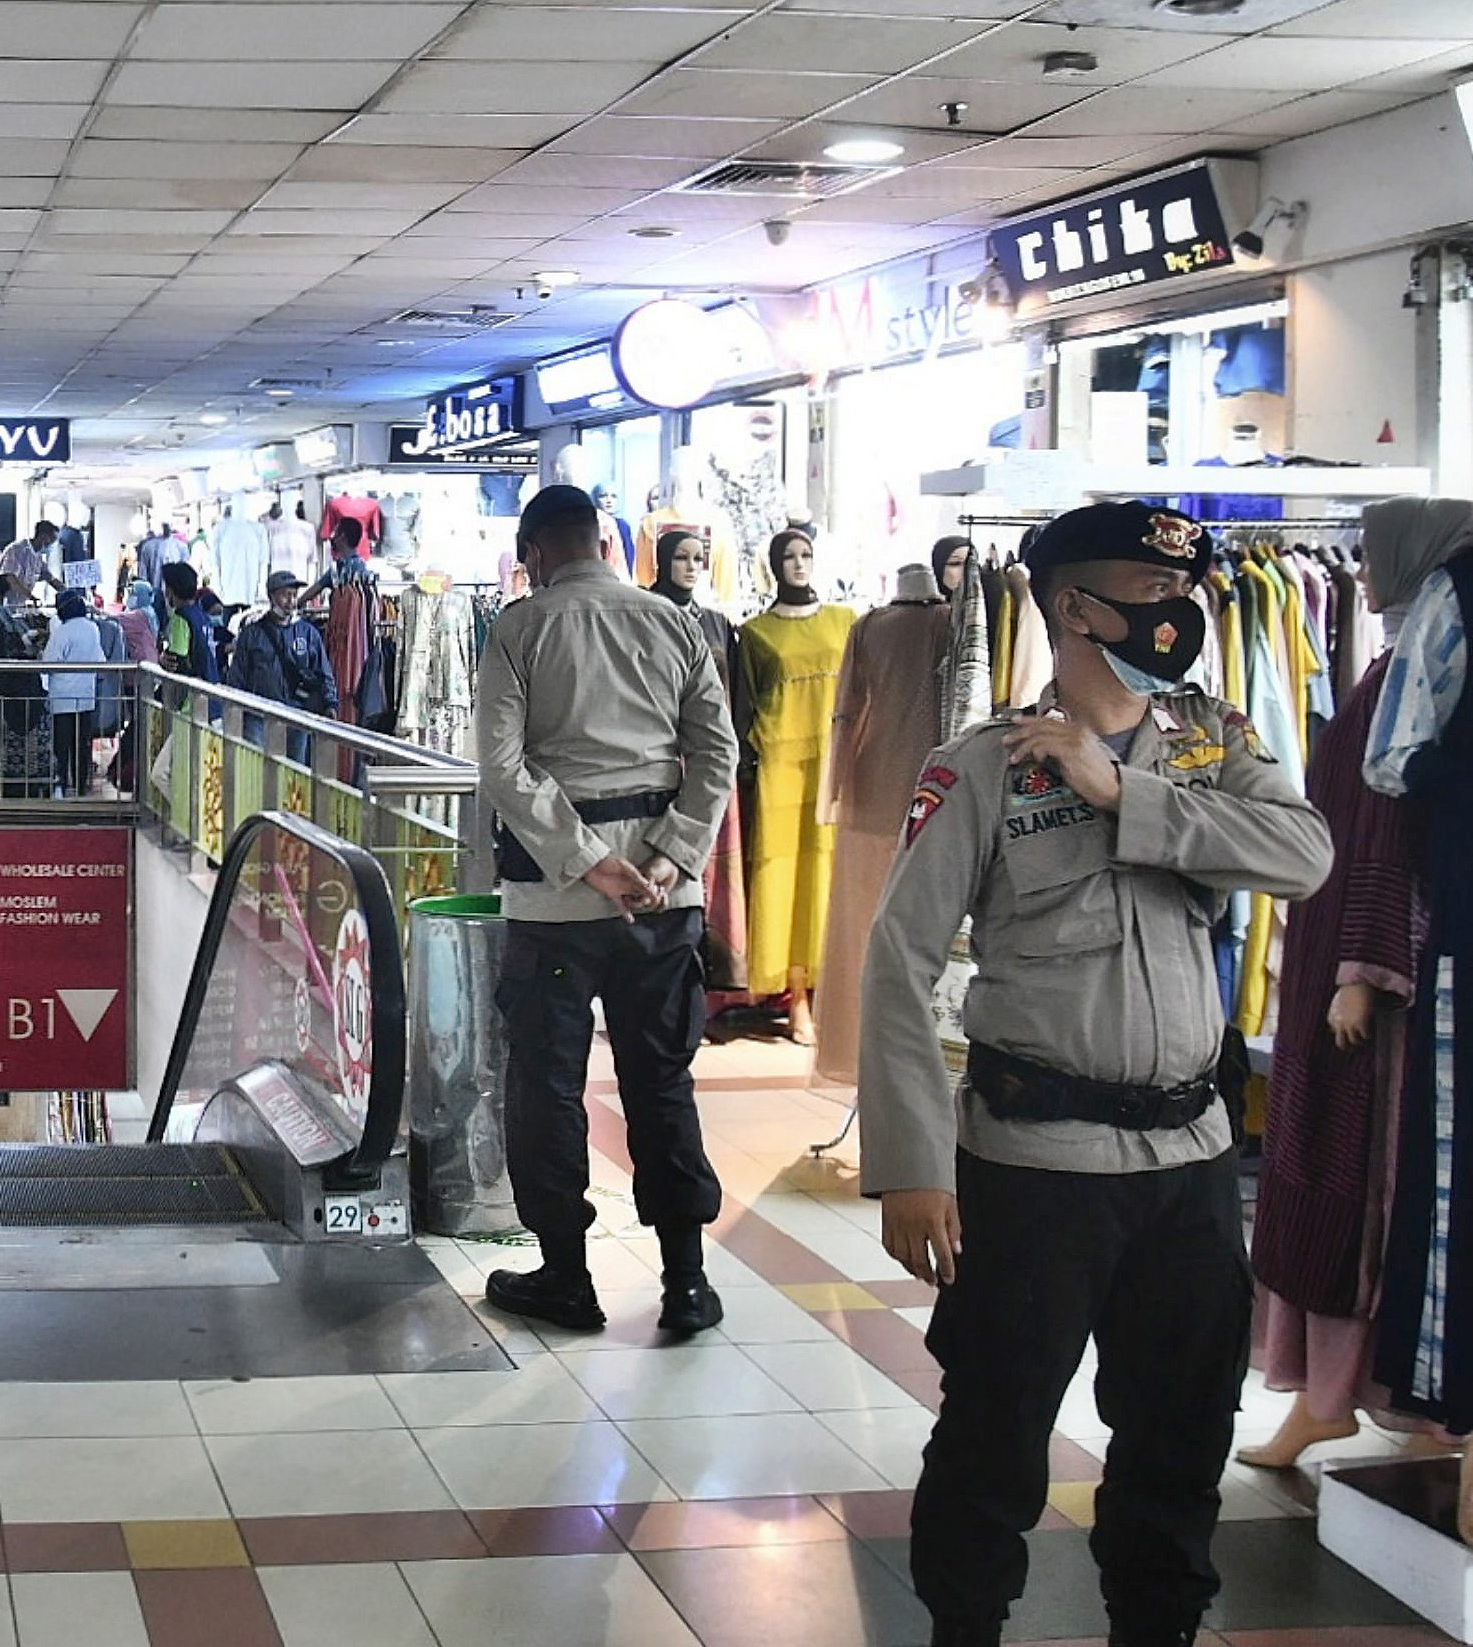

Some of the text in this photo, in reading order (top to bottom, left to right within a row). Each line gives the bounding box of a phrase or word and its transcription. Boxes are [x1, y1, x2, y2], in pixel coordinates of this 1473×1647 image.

[886, 285, 973, 351] style
[0, 864, 126, 877] WHOLESALE CENTER
[0, 895, 58, 909] MOSLEM
[0, 912, 102, 926] FASHION WEAR
[8, 998, 55, 1040] B1
[329, 1205, 358, 1228] 29
